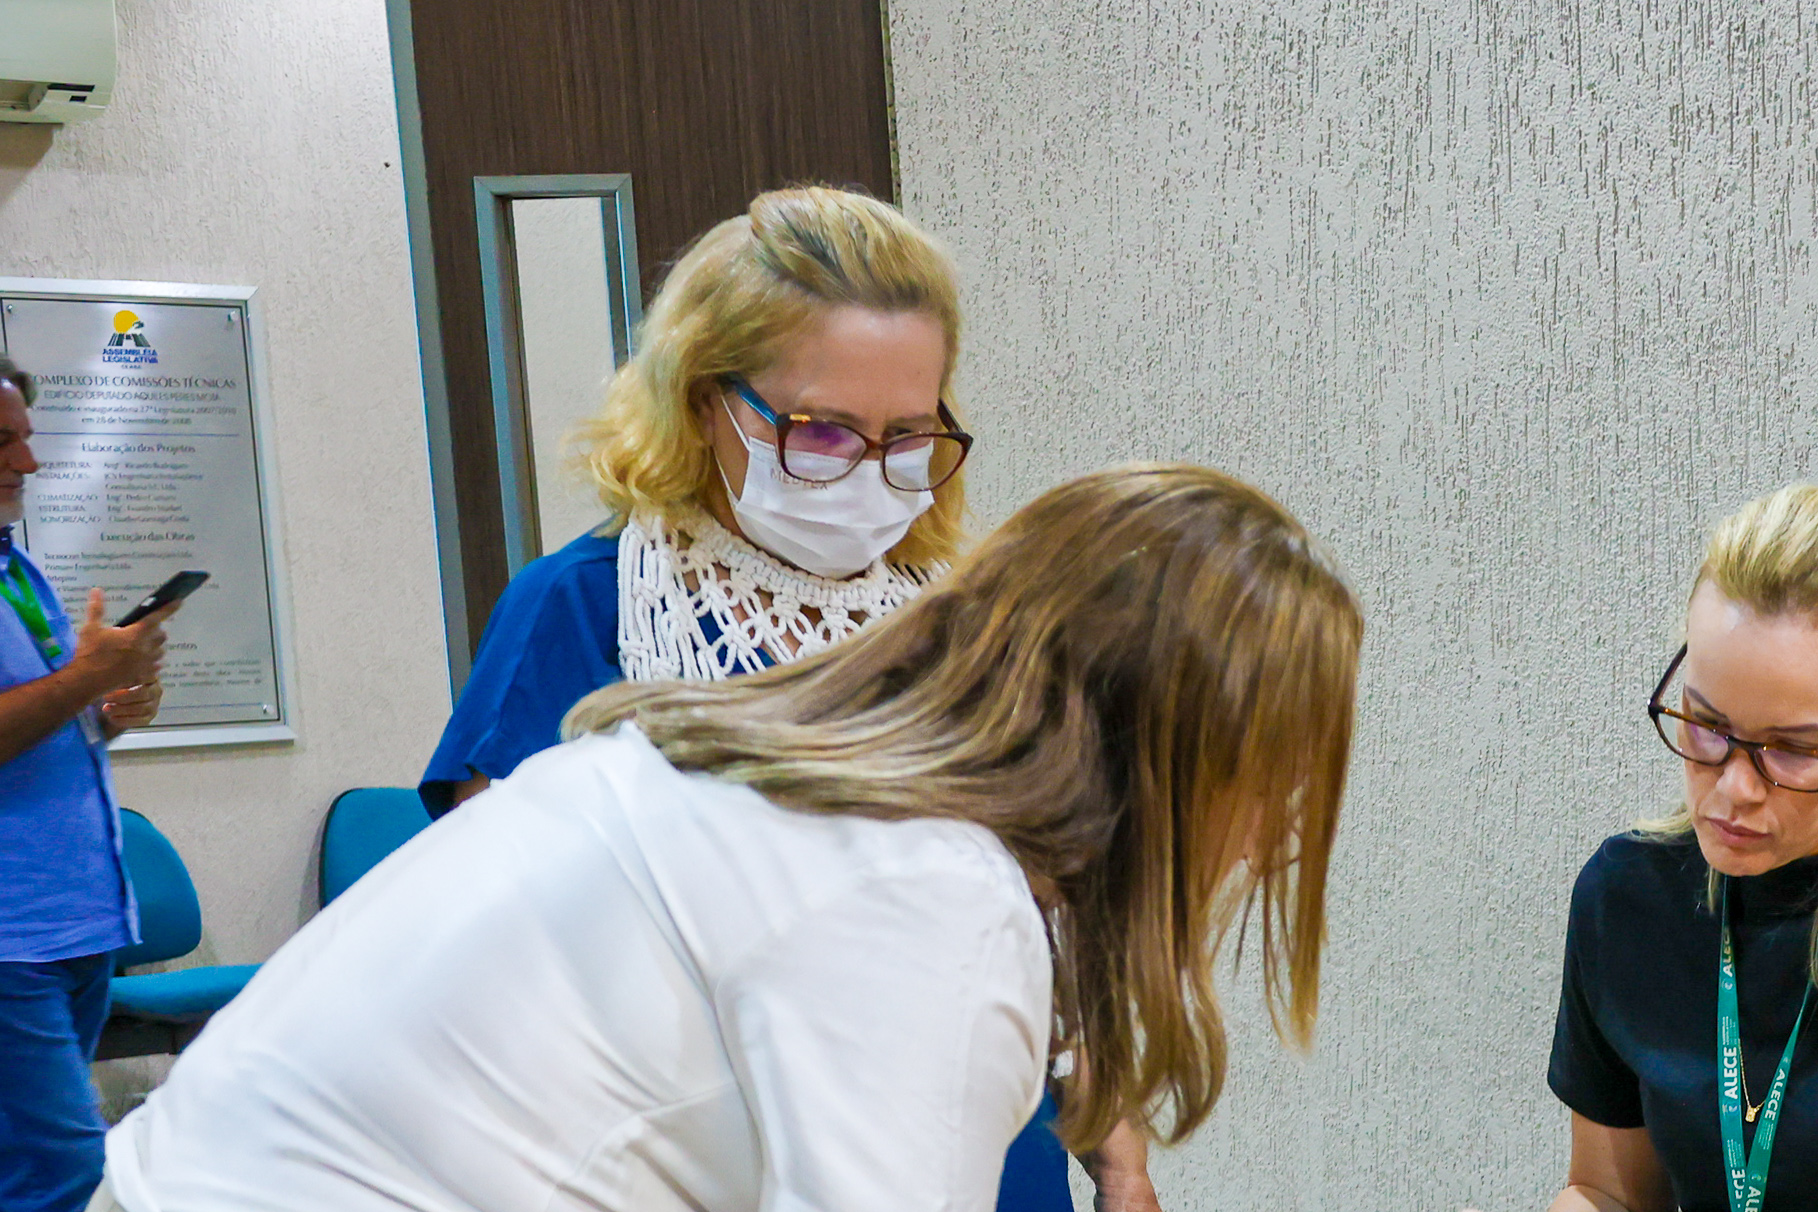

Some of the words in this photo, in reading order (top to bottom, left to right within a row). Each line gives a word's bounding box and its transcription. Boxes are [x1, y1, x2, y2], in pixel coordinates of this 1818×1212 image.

[95, 375, 110, 386] DE
[82, 442, 136, 455] Elaboração
[1724, 1046, 1739, 1100] ALECE
[1764, 1067, 1786, 1121] ALECE
